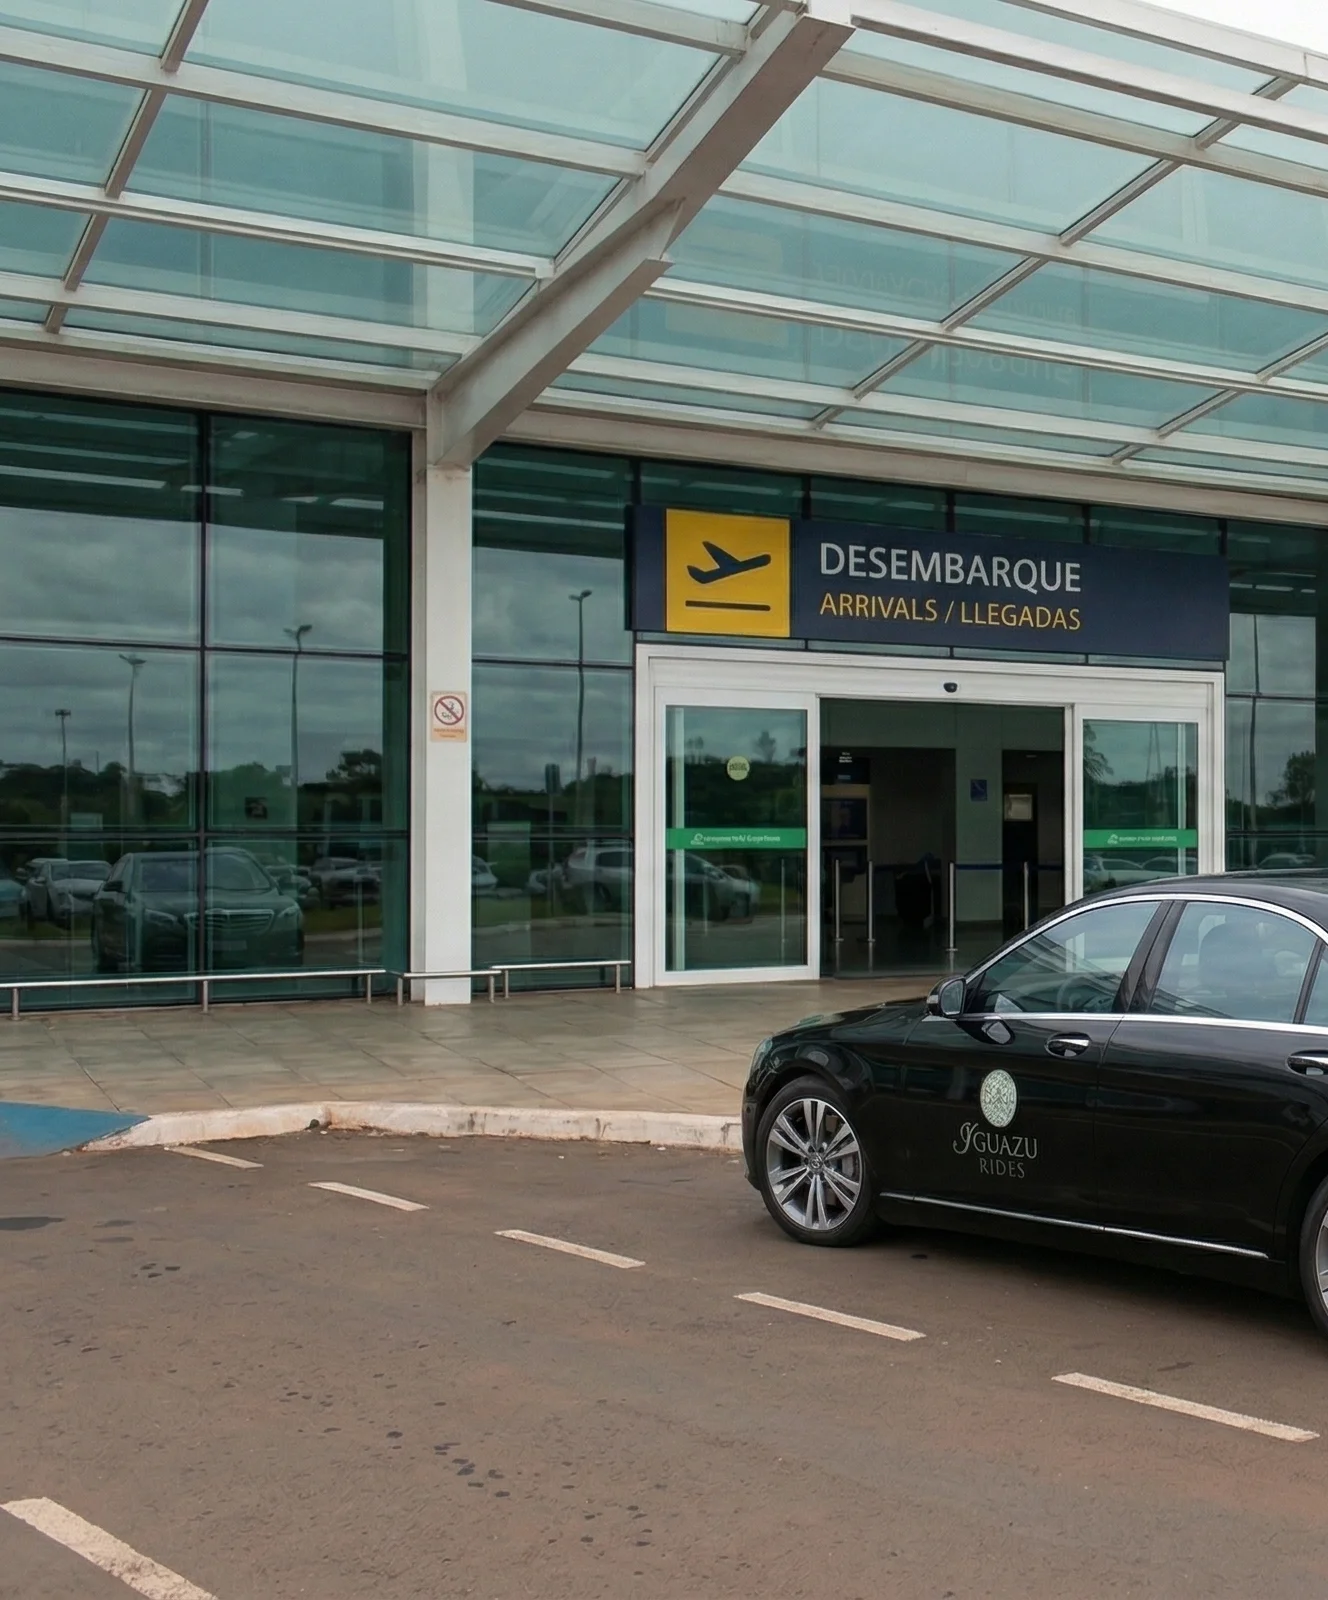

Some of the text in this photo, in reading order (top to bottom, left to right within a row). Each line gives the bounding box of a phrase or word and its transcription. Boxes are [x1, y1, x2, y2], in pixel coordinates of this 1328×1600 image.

[820, 543, 1081, 595] DESEMBARQUE
[819, 593, 938, 622] ARRIVALS
[960, 602, 1081, 631] LLEGADAS
[979, 1157, 1025, 1179] RIDES
